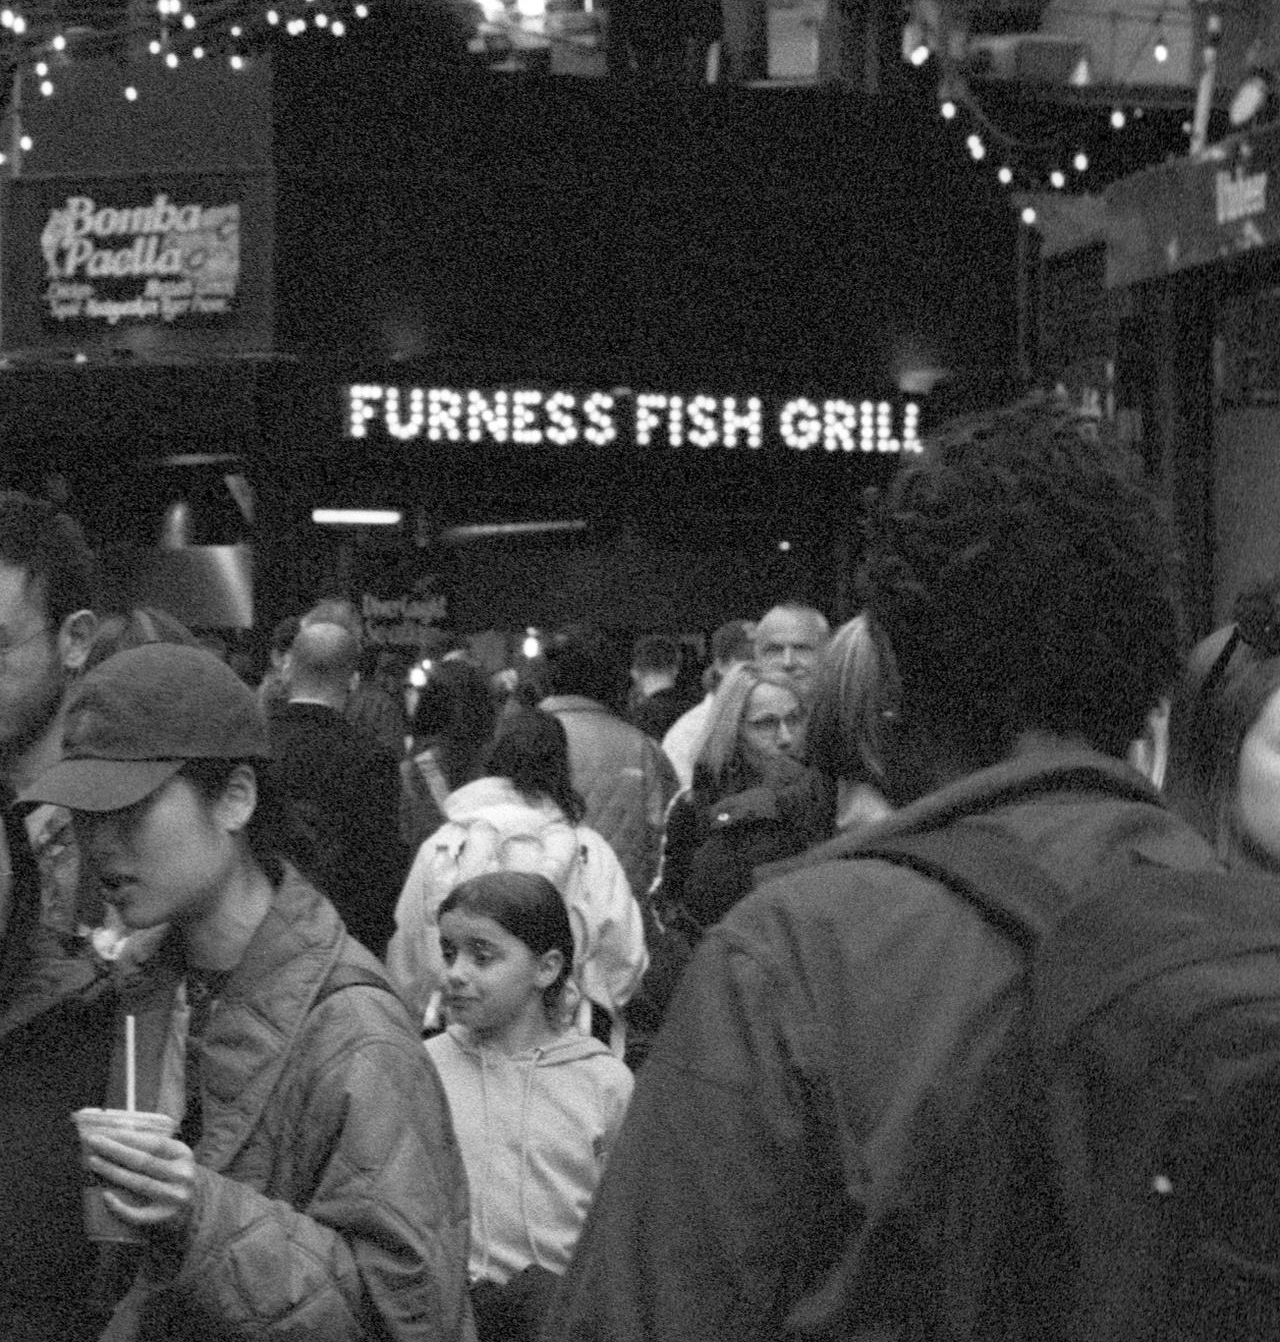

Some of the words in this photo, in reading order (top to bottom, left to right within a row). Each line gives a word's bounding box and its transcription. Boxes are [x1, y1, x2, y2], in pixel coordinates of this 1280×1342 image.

[66, 194, 202, 236] Bomba
[63, 235, 182, 277] Paella
[350, 385, 617, 446] FURNESS
[636, 393, 762, 448] FISH
[779, 397, 924, 455] GRILL
